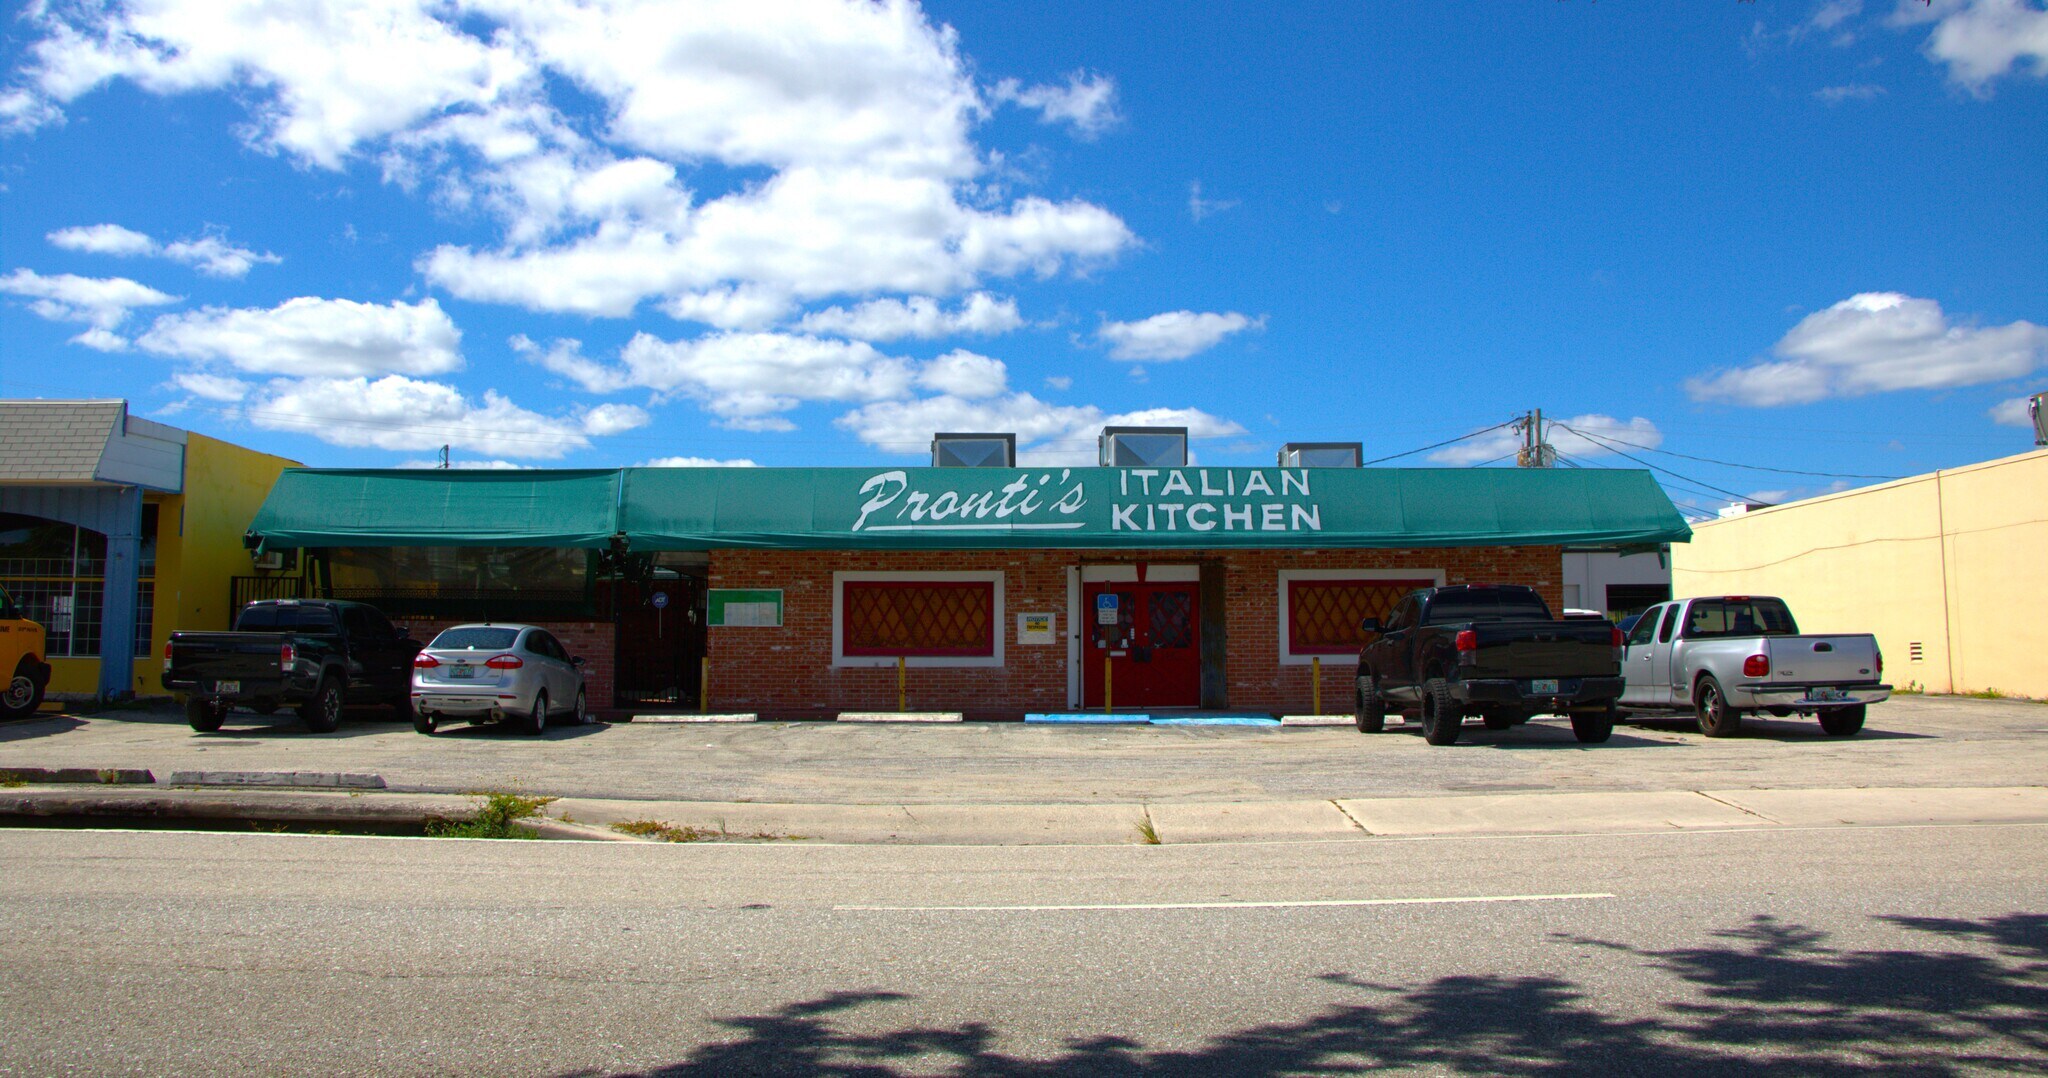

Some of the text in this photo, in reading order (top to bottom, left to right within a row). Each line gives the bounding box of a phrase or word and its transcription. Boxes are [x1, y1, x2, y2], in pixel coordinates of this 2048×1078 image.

[1120, 469, 1310, 496] ITALIAN
[852, 468, 1088, 532] Pronti's
[1112, 502, 1322, 531] KITCHEN
